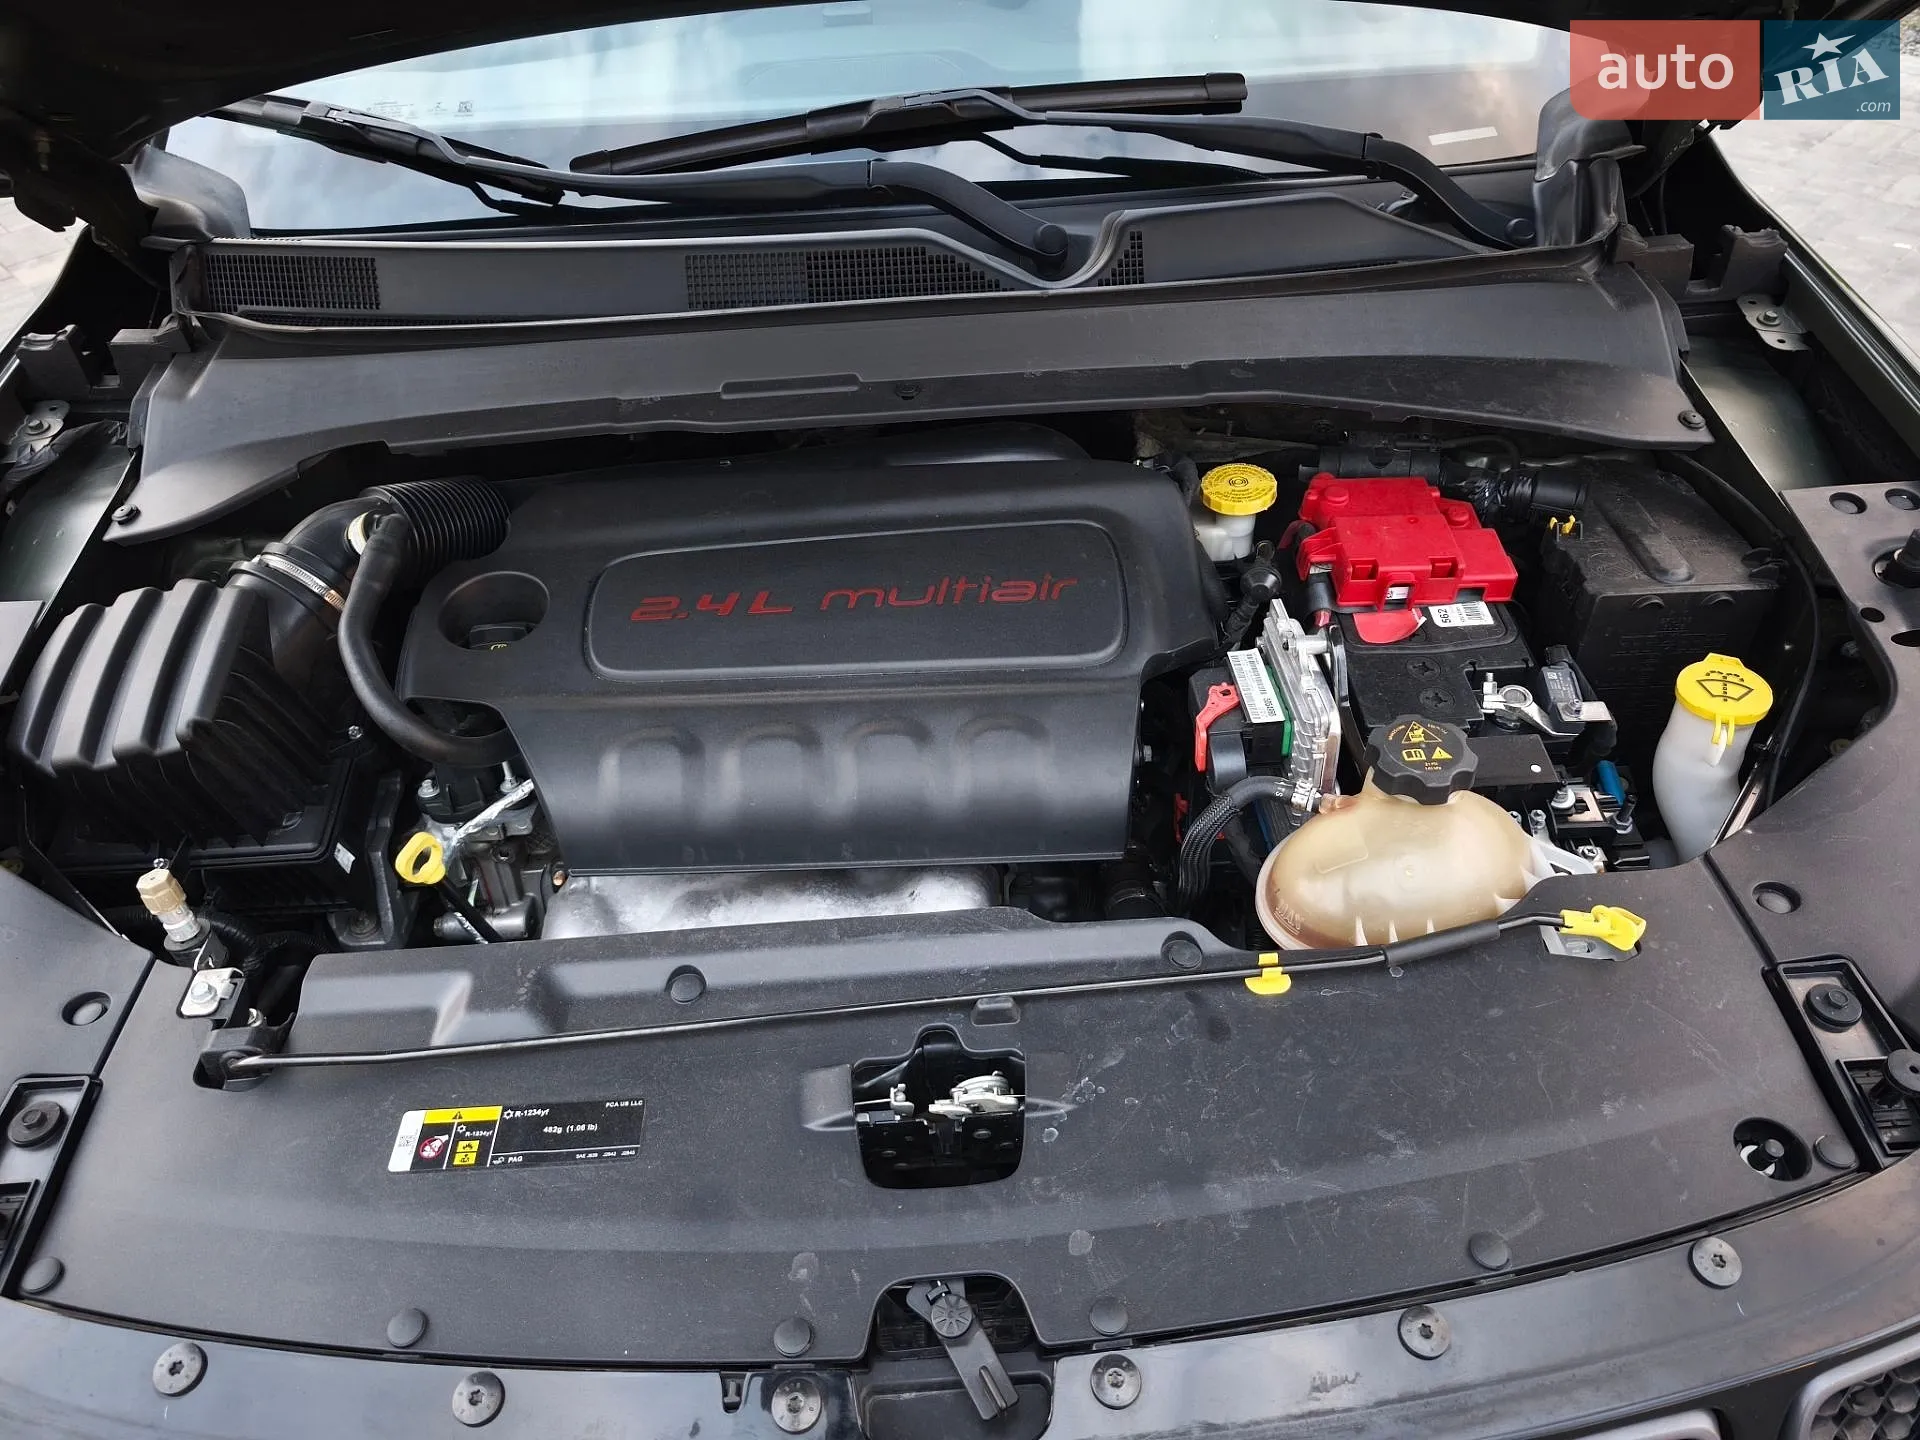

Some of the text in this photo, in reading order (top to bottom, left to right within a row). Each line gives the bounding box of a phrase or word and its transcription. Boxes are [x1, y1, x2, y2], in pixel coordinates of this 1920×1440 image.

[819, 573, 1079, 611] multiair
[605, 1100, 619, 1108] FCA
[514, 1108, 550, 1118] R-1234yf
[542, 1125, 563, 1134] 482g
[587, 1123, 598, 1132] lb)
[507, 1156, 523, 1164] PAG
